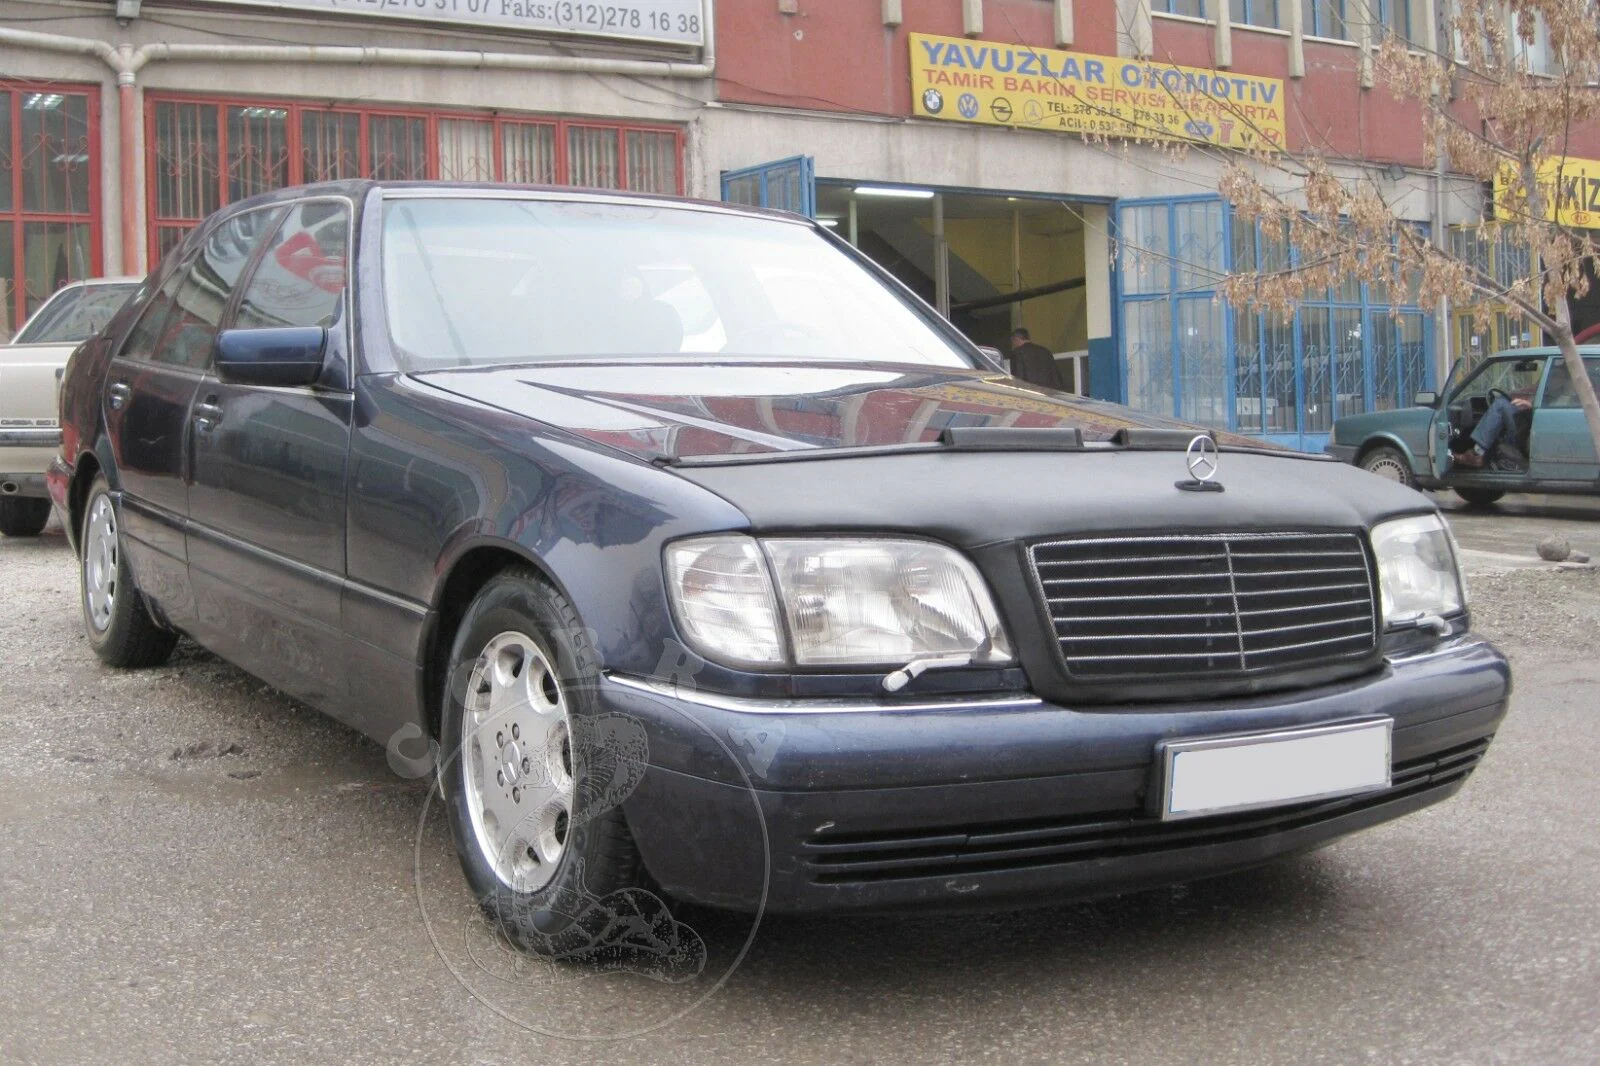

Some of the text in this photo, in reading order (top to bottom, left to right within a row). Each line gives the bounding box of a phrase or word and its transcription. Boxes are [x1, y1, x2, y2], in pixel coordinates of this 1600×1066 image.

[650, 11, 670, 31] 16
[678, 14, 700, 33] 38
[920, 40, 1105, 84] YAVUZLAR
[1047, 101, 1070, 113] TEL:
